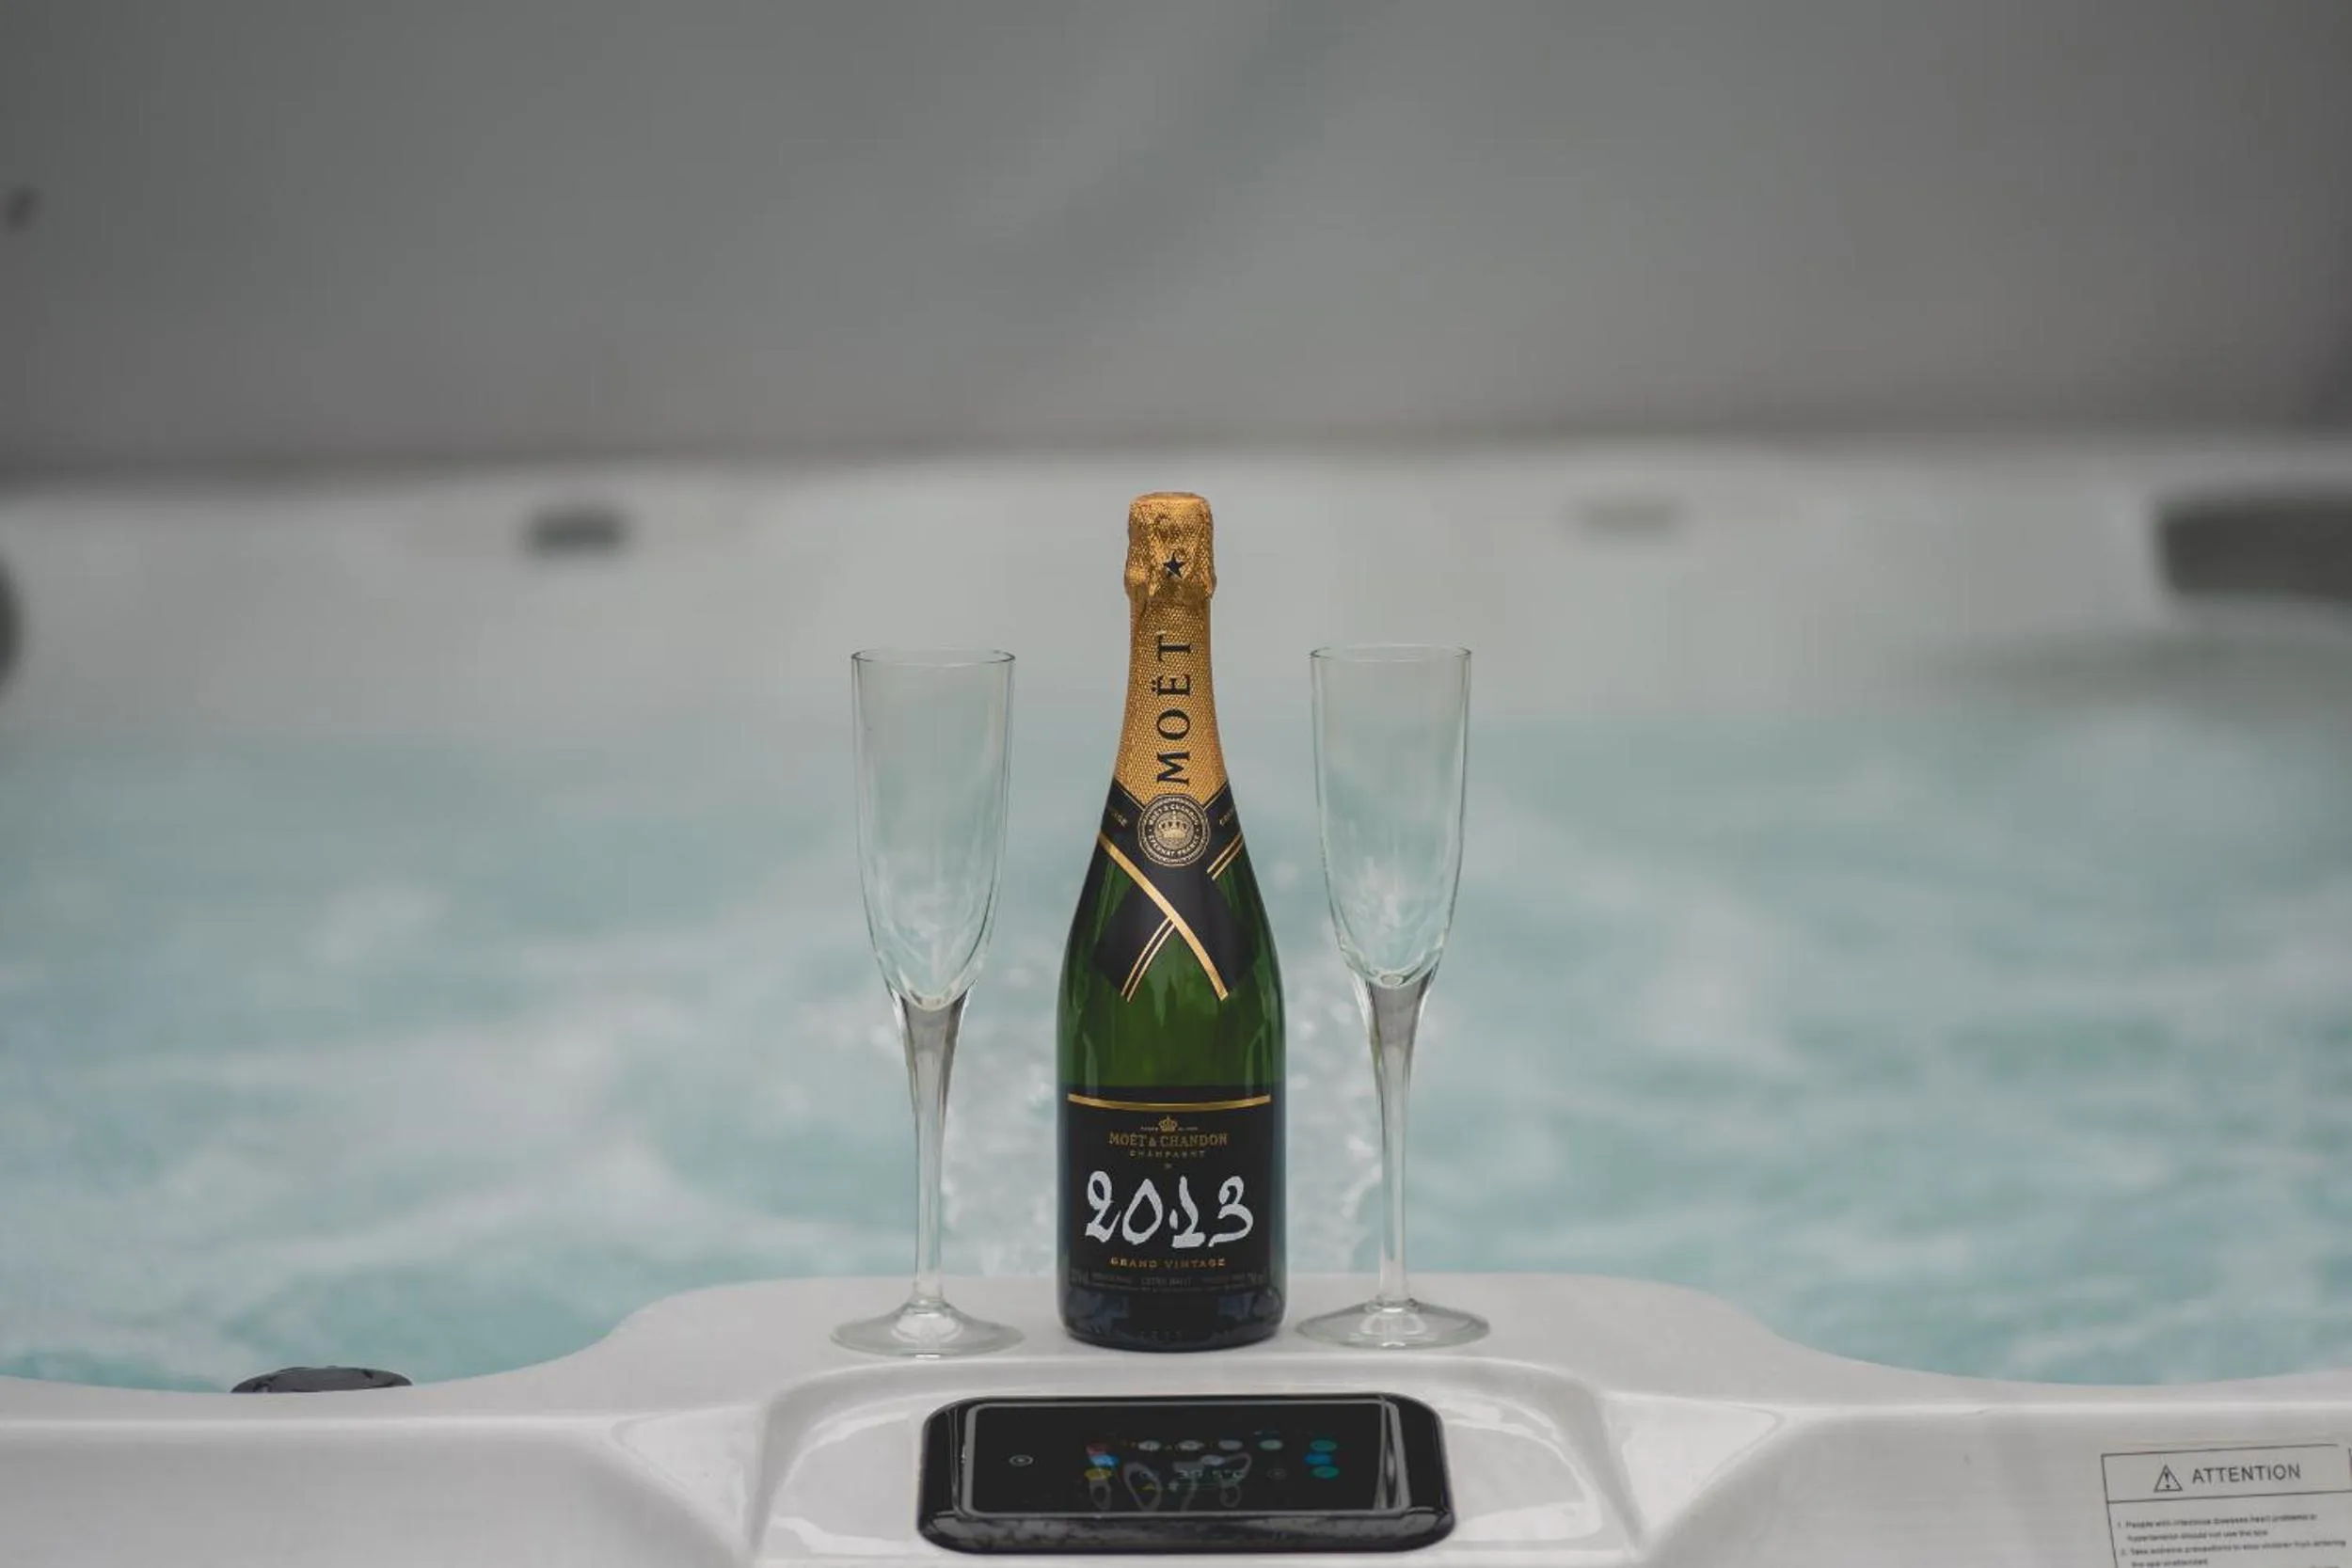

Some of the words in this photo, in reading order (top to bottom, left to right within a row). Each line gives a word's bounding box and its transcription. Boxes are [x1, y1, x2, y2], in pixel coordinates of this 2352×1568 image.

[1151, 635, 1191, 784] MOËT
[1159, 1132, 1229, 1148] CHANDON
[1085, 1170, 1254, 1249] 2013
[1110, 1257, 1158, 1269] GRAND
[1165, 1257, 1227, 1269] VINTAGE
[2192, 1464, 2301, 1483] ATTENTION
